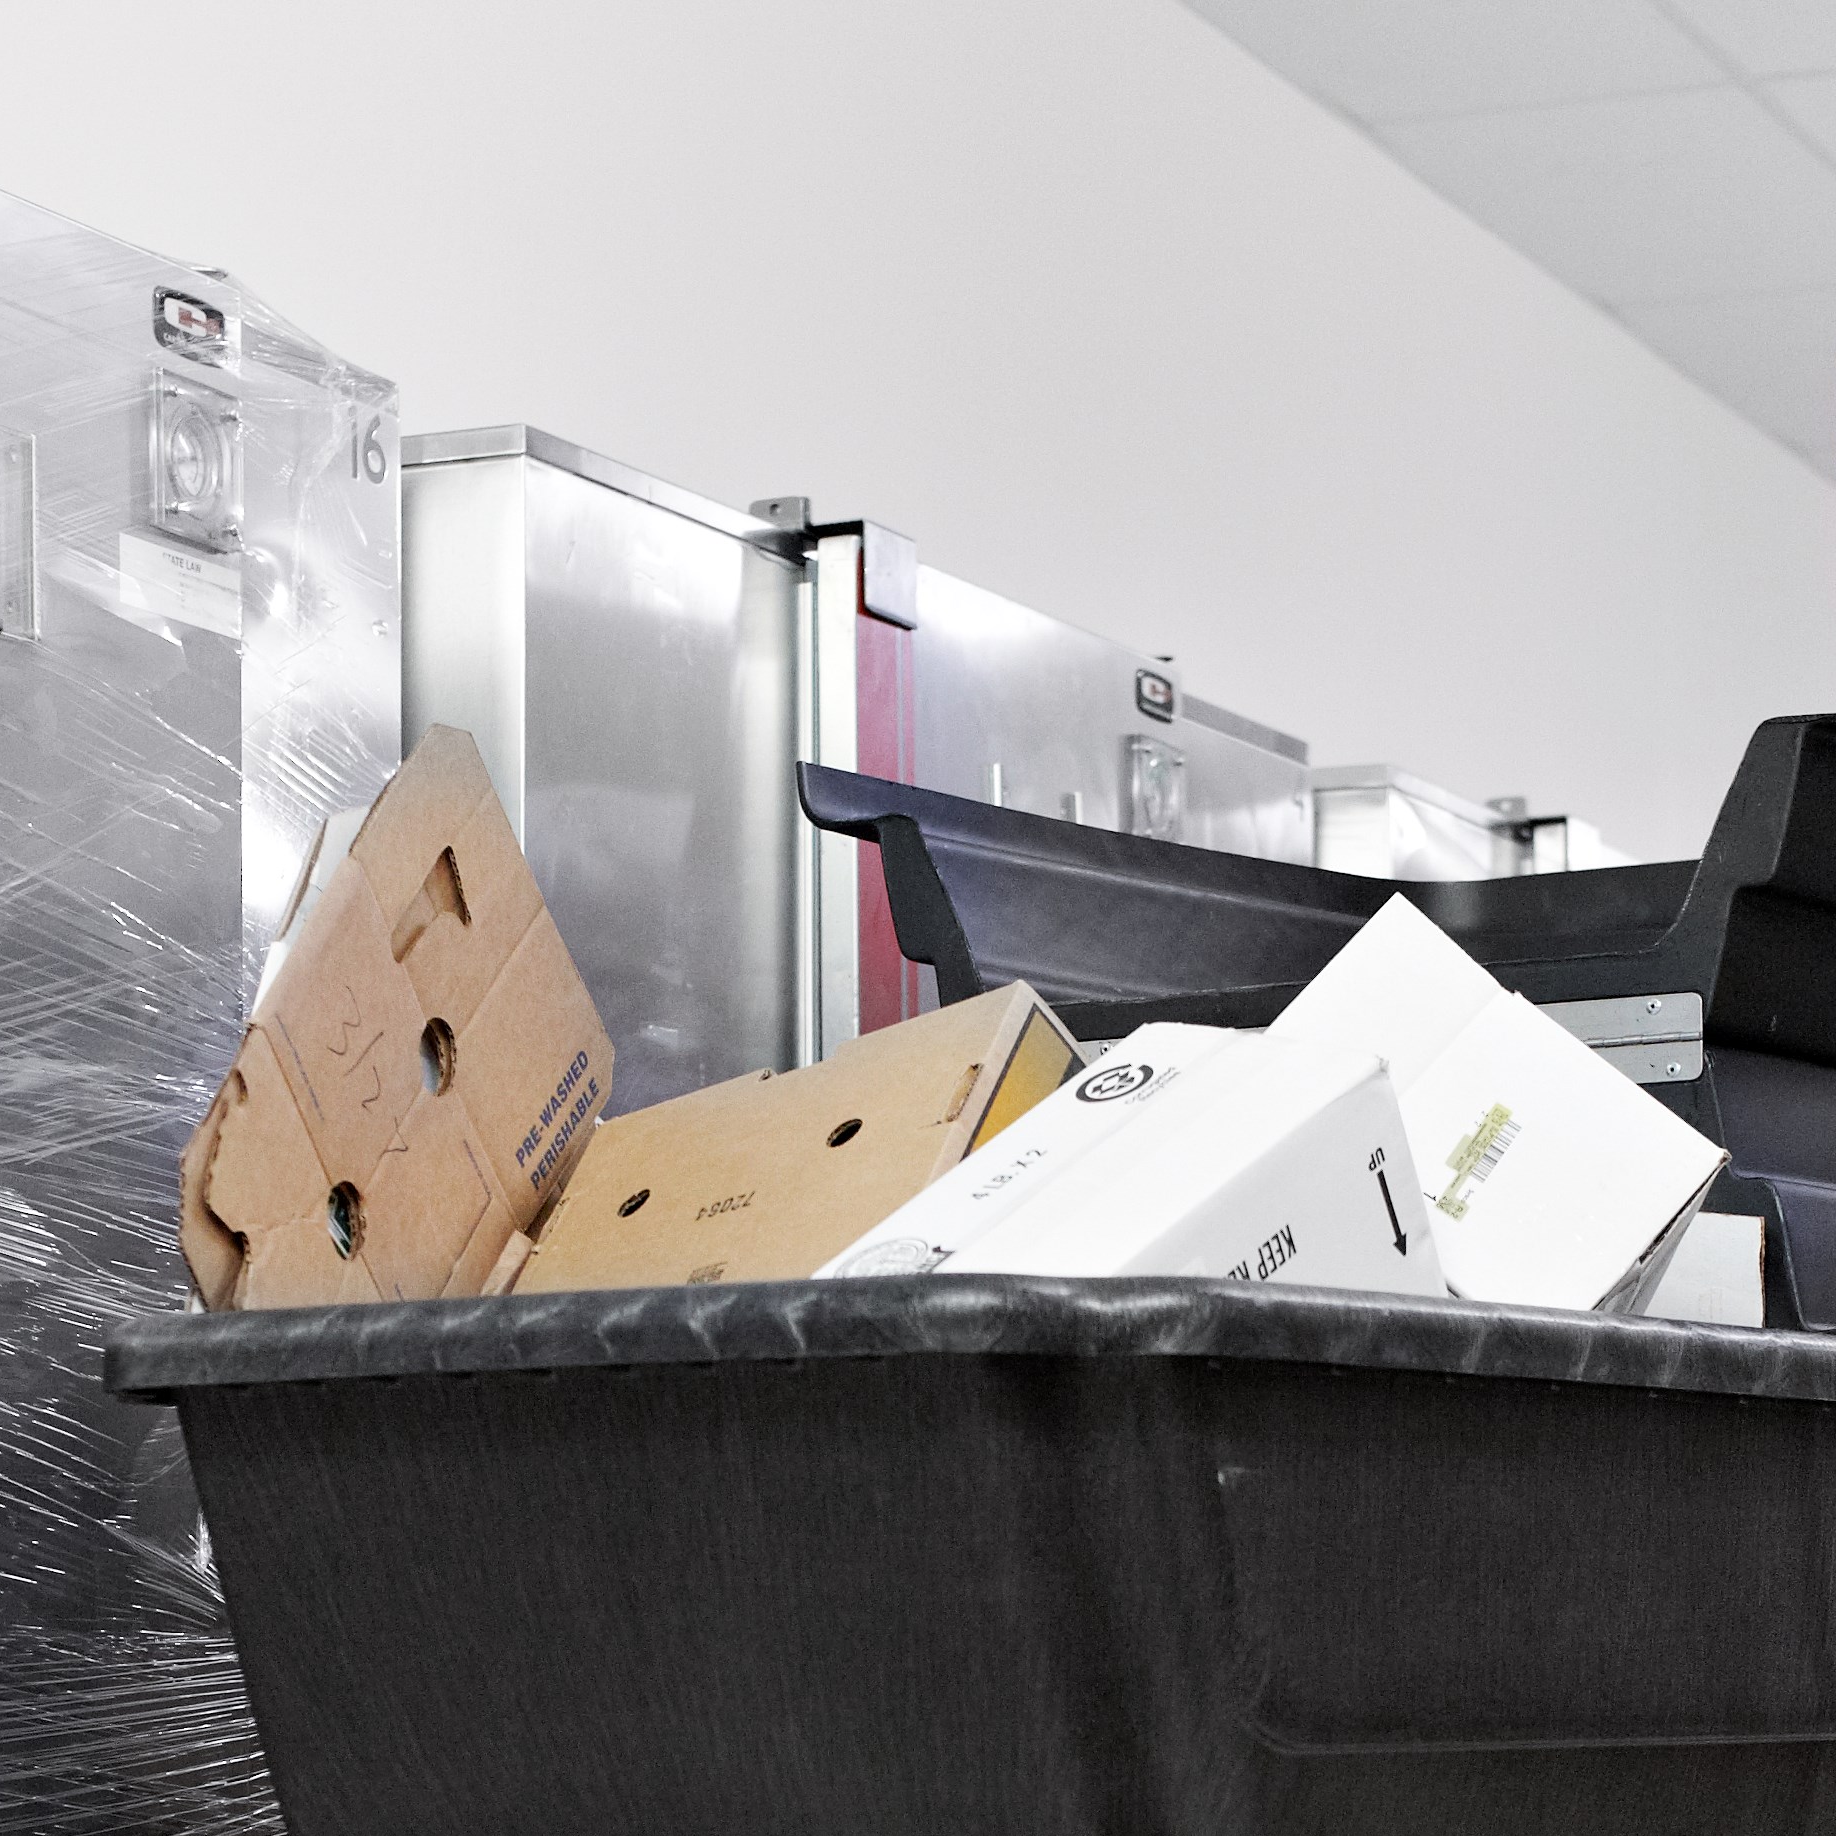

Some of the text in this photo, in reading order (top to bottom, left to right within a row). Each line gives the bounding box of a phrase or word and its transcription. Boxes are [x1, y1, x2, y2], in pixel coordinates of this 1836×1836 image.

[348, 405, 386, 484] 16
[515, 1050, 589, 1168] PRE-WASHED
[530, 1077, 599, 1190] PERISHABLE
[1368, 1147, 1385, 1171] UP
[1258, 1224, 1297, 1281] KEEP
